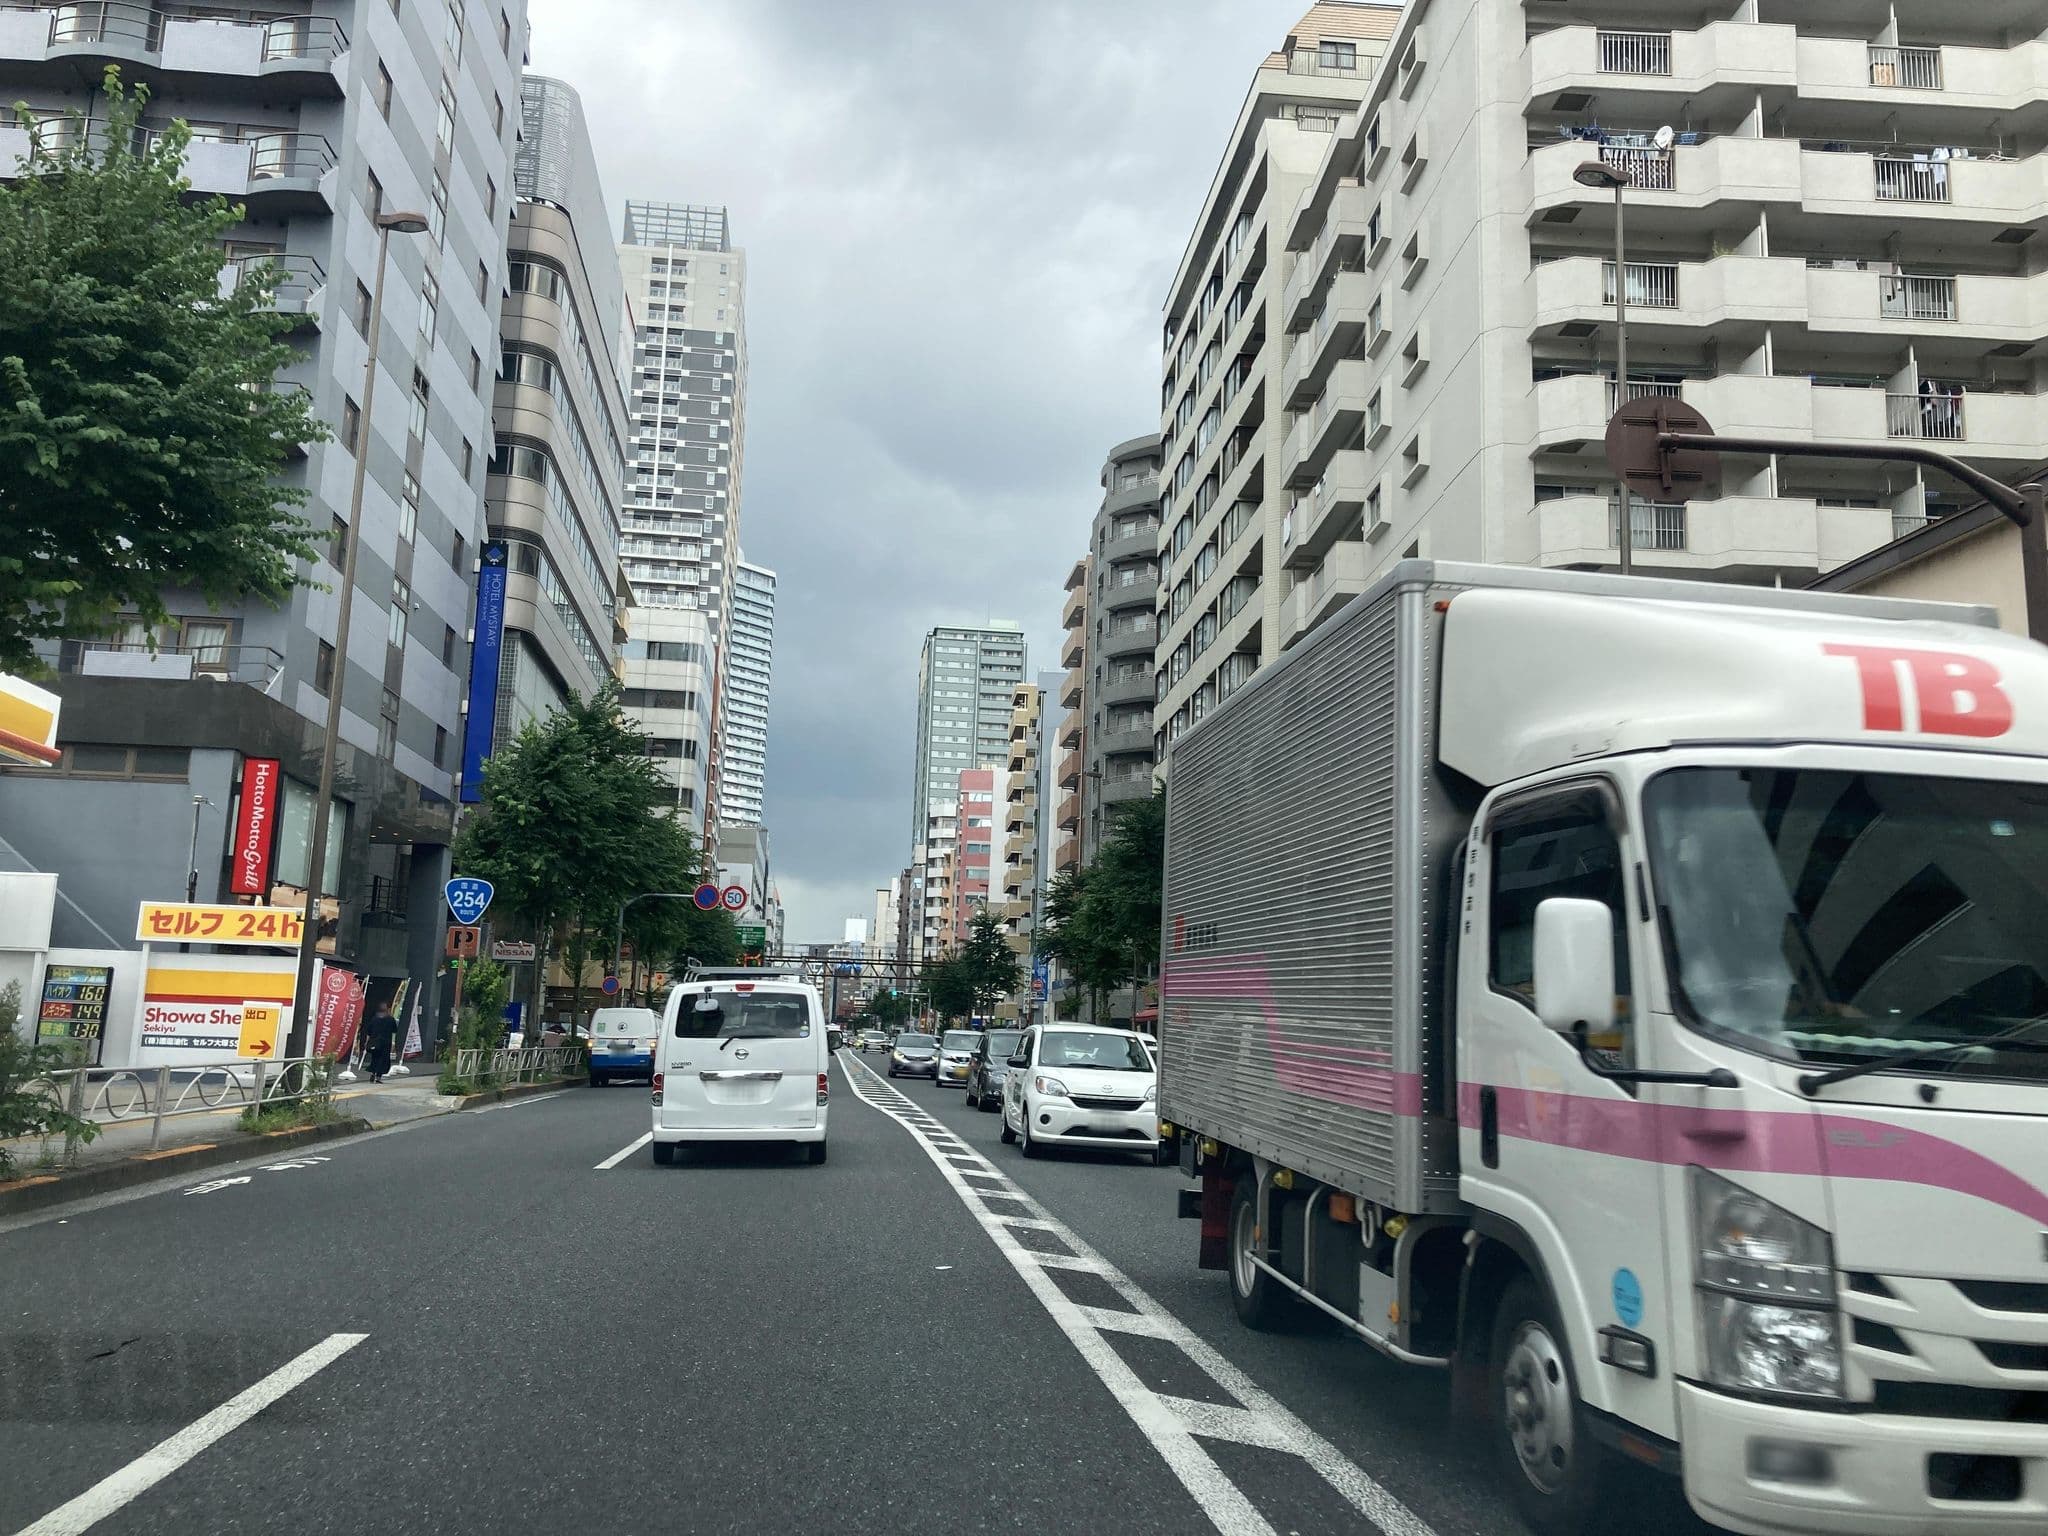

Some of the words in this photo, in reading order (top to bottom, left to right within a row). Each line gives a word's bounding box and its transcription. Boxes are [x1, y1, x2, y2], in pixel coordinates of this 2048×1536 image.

[490, 573, 501, 601] HOTEL
[486, 605, 498, 647] MYSTAYS
[1819, 642, 2015, 739] TB
[453, 890, 485, 909] 254
[727, 892, 742, 904] 50
[150, 910, 224, 936] セルフ
[236, 913, 300, 938] 24h
[46, 985, 73, 998] ハイオク
[80, 986, 105, 1001] 160
[42, 1004, 72, 1017] レギュラー
[77, 1005, 102, 1019] 149
[145, 1007, 206, 1023] Showa
[245, 1010, 267, 1020] 出口
[74, 1023, 99, 1038] 130
[143, 1024, 176, 1034] Sekiyu
